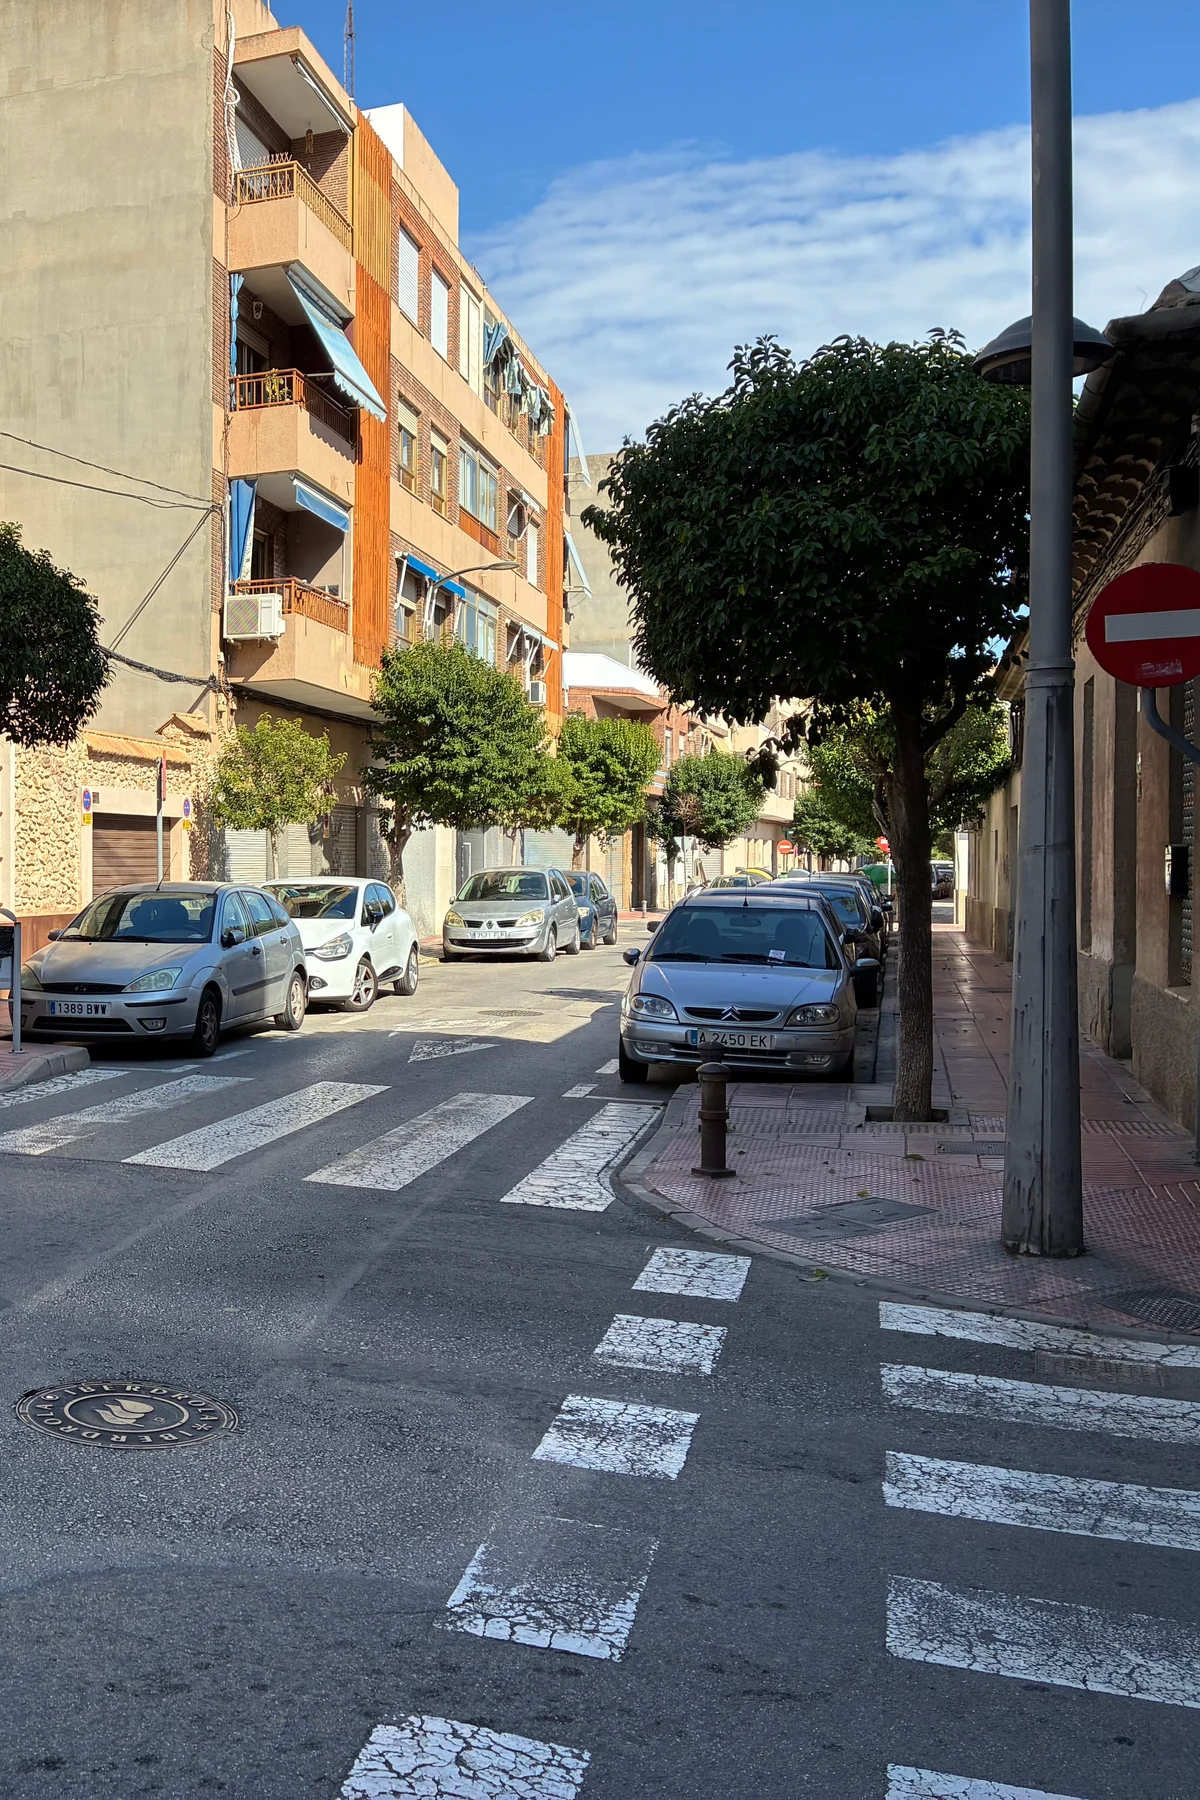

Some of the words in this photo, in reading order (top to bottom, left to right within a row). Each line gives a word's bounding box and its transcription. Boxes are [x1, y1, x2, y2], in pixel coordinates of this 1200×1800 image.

[58, 1003, 83, 1014] 1389
[86, 1004, 107, 1015] BWW
[699, 1031, 706, 1043] A
[712, 1033, 746, 1047] 2450
[750, 1035, 767, 1048] EK
[63, 1384, 219, 1422] IBERDROLA
[35, 1404, 194, 1443] IBERDROLA
